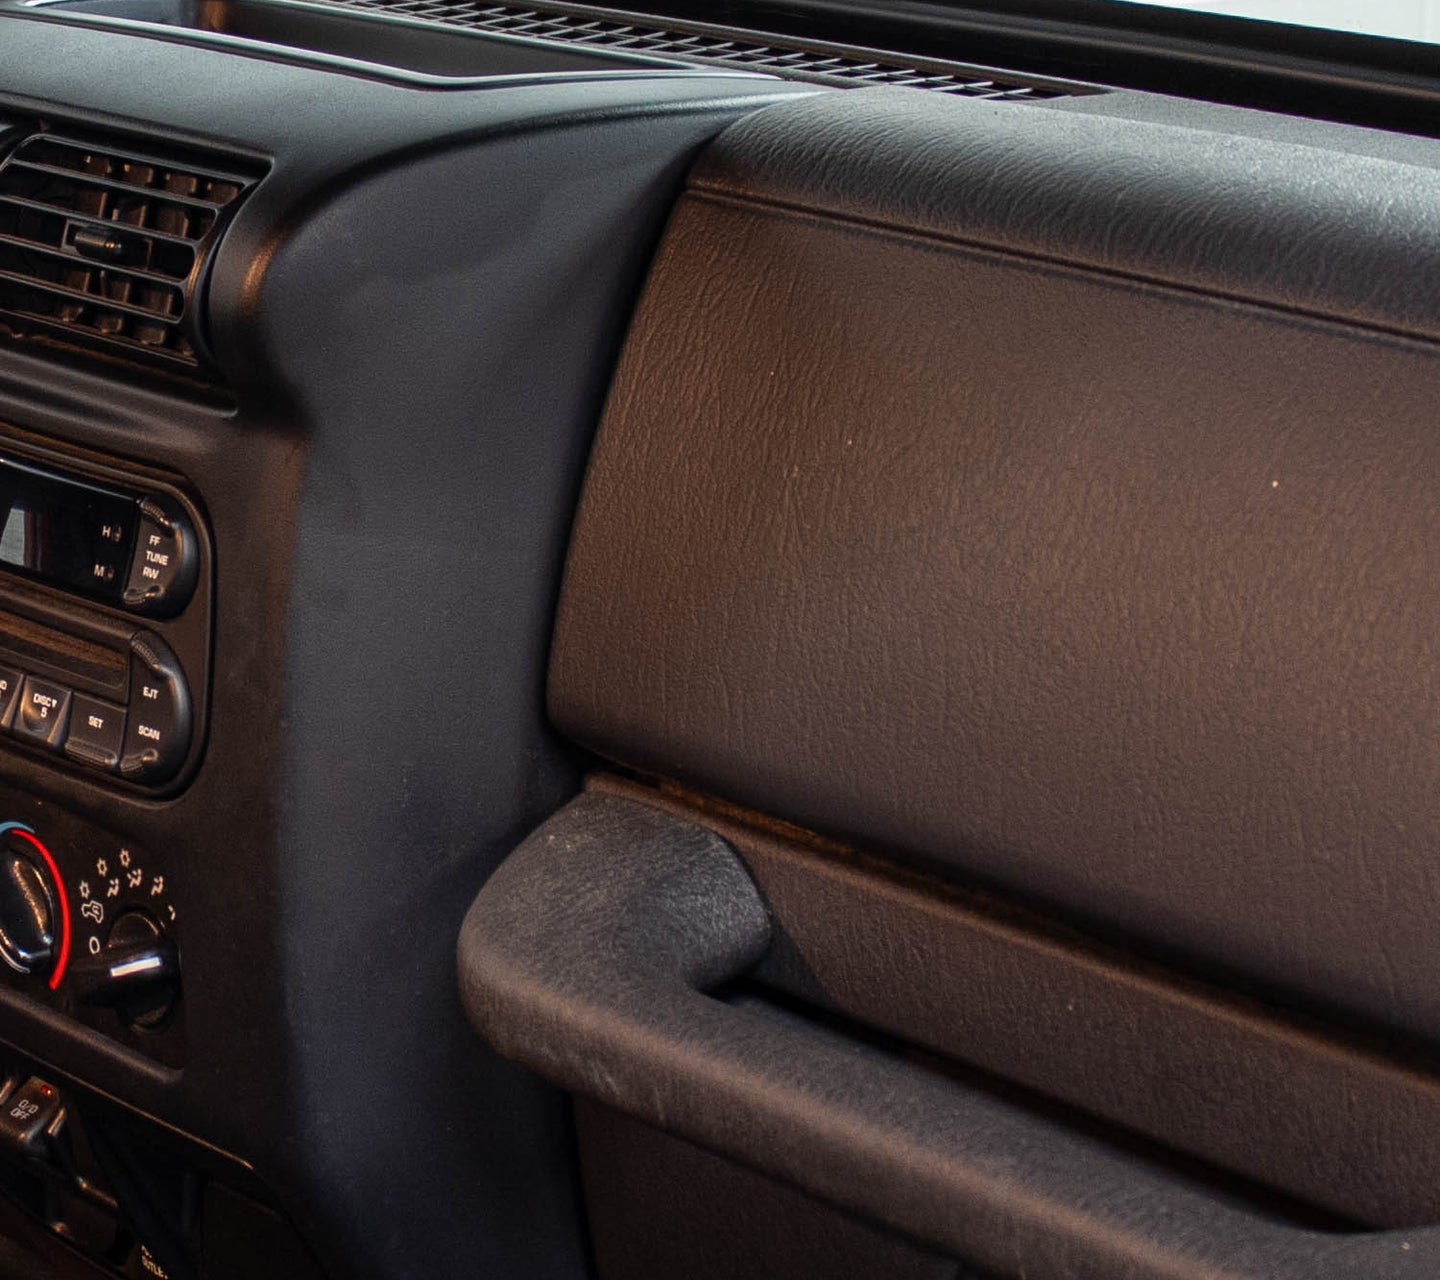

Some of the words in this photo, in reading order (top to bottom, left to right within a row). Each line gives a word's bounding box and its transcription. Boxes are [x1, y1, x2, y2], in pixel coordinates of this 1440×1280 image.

[149, 534, 161, 547] FF
[146, 550, 168, 566] TUNE
[142, 566, 159, 580] RW
[143, 686, 158, 699] EJT
[33, 693, 52, 709] DISC
[40, 706, 48, 719] 5
[88, 715, 103, 729] SET
[138, 725, 160, 741] SCAN
[10, 1107, 30, 1121] OFF
